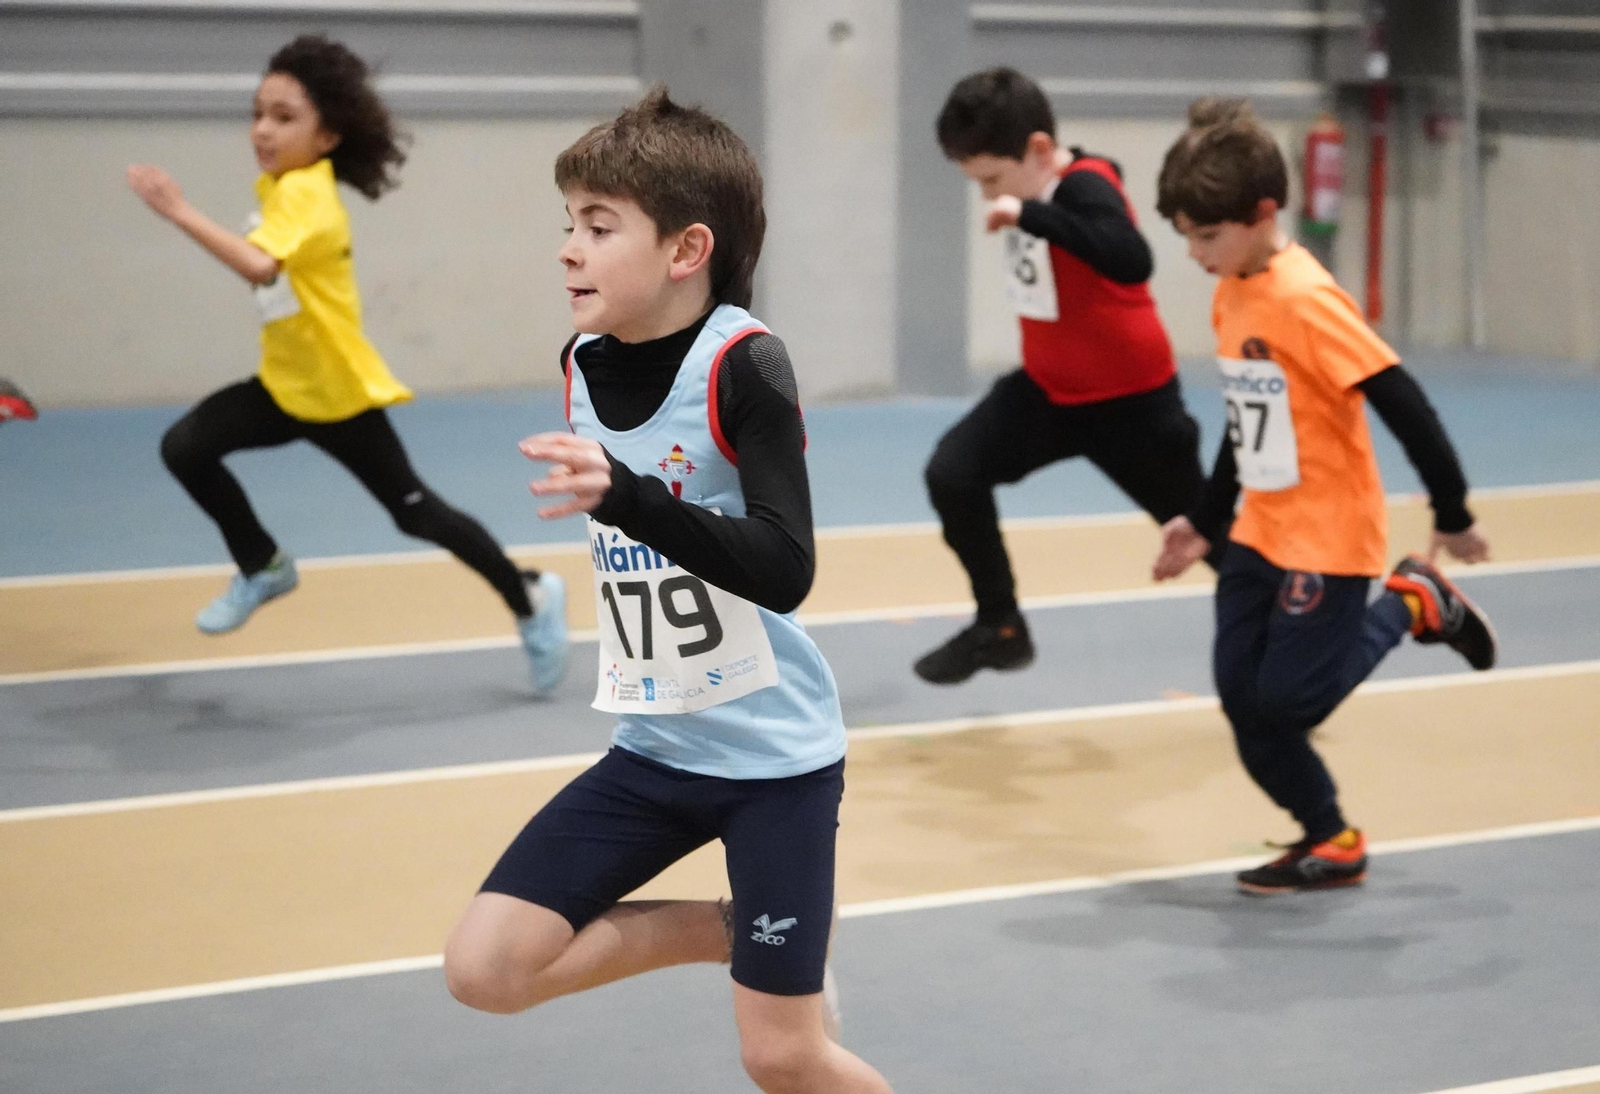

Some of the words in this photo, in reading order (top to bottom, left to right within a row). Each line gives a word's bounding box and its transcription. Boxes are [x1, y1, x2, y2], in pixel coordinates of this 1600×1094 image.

[601, 575, 724, 660] 179
[728, 663, 758, 679] GALEGO
[657, 690, 667, 699] DE
[669, 687, 706, 699] GALICIA
